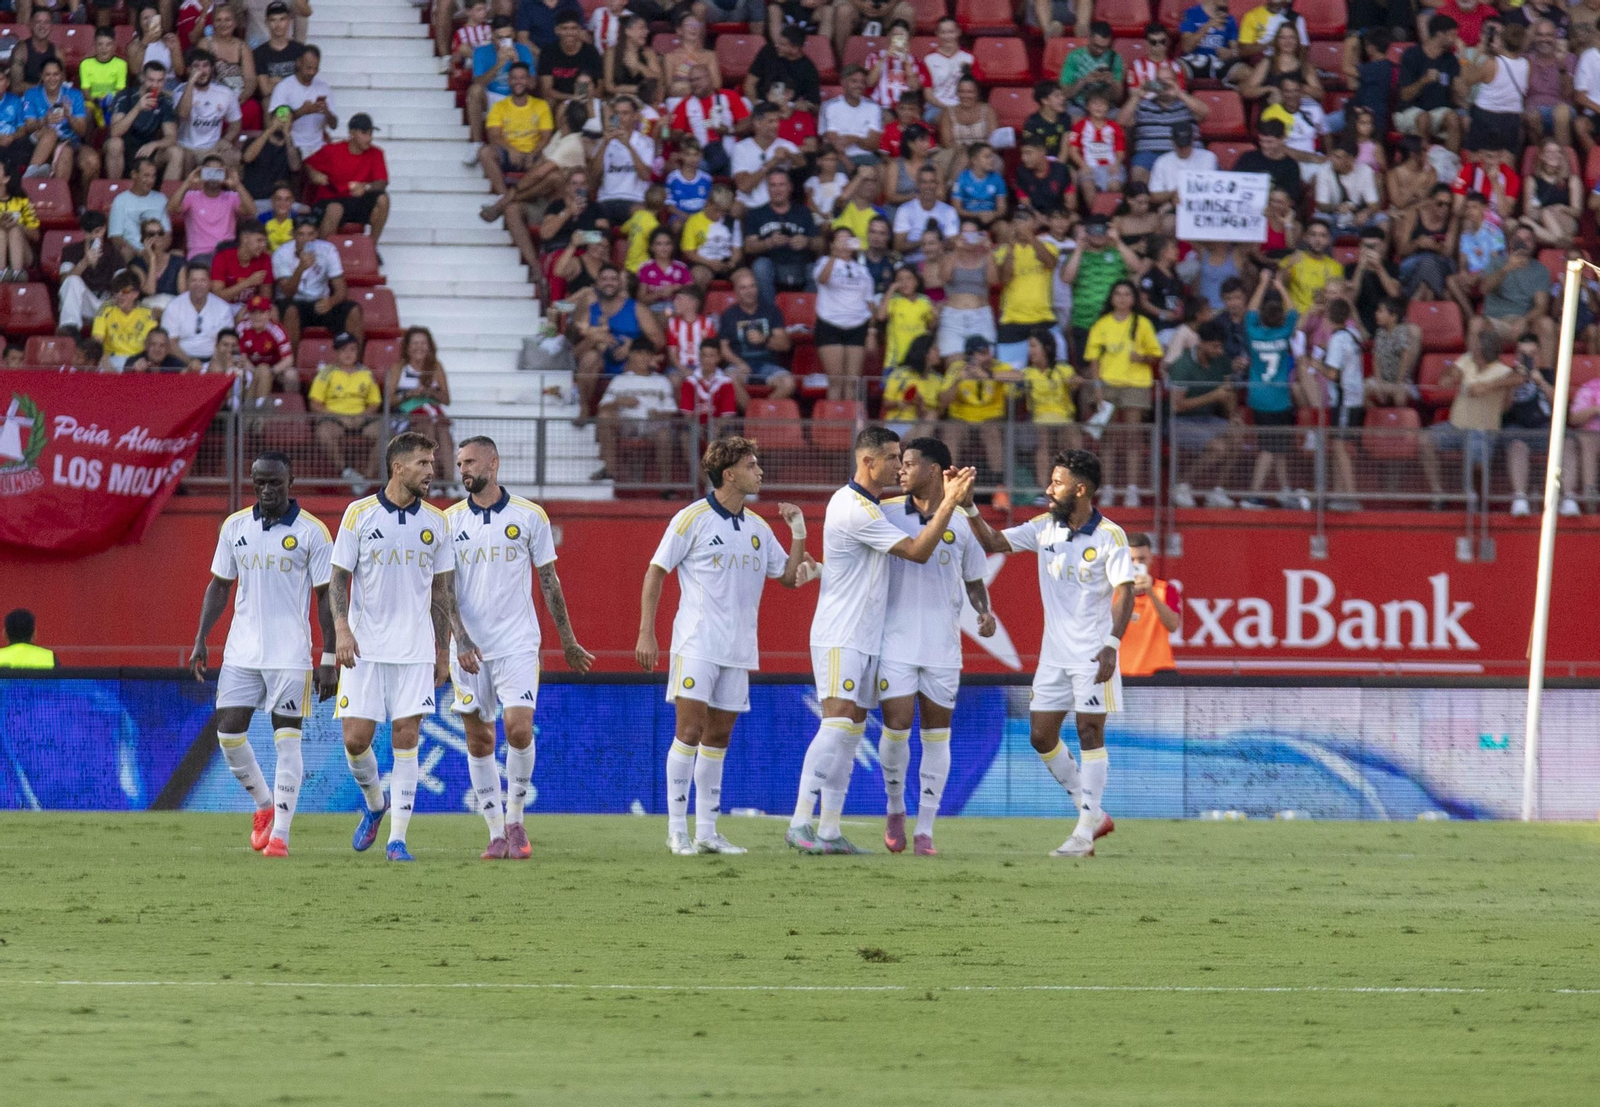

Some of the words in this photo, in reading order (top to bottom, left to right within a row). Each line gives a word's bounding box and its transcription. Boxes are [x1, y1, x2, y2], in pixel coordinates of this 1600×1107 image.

[1258, 352, 1281, 383] 7
[53, 415, 112, 447] Peña
[53, 453, 104, 491] LOS
[238, 553, 294, 573] KAFD
[371, 548, 429, 568] KAFD
[459, 546, 518, 565] KAFD
[712, 553, 762, 572] KAFD
